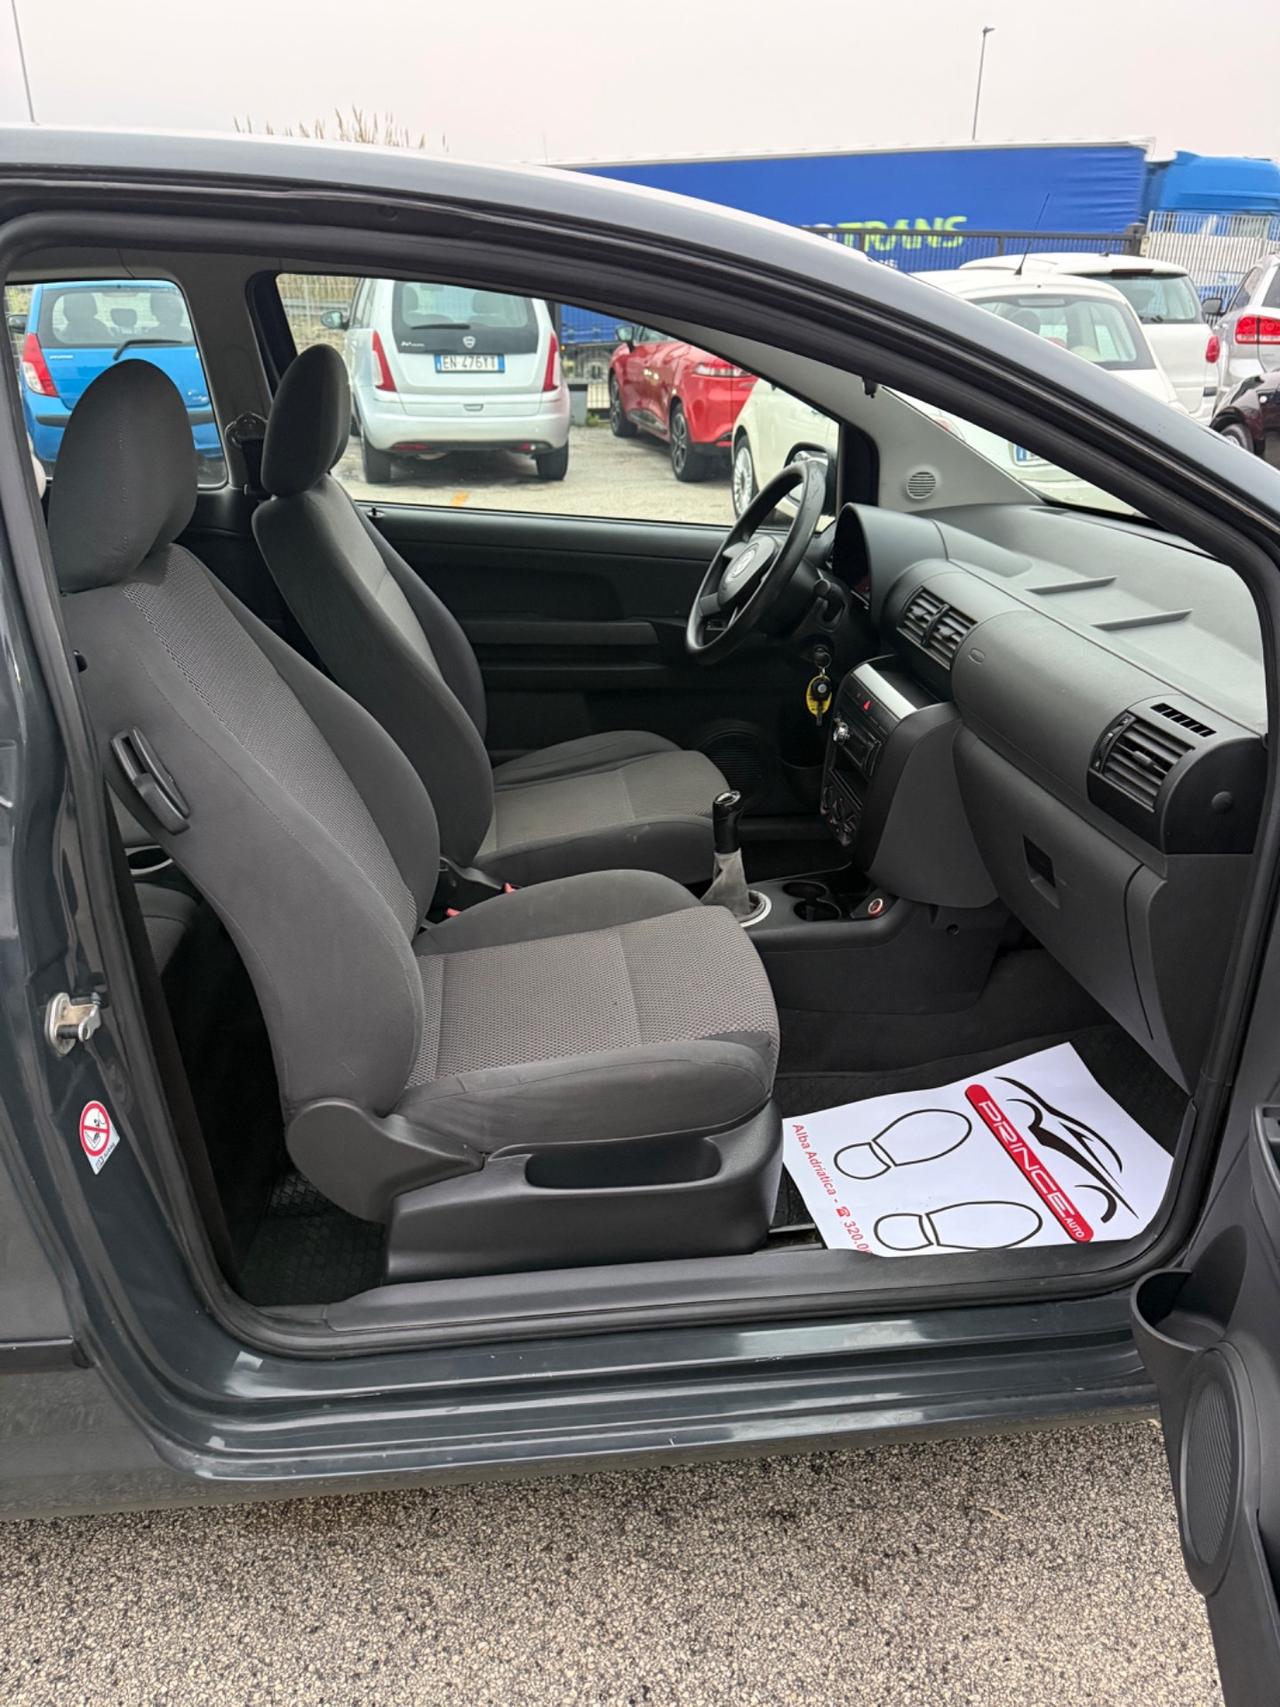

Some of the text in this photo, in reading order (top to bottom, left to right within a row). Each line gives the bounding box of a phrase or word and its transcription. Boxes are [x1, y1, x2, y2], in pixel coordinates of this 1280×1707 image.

[792, 1123, 811, 1150] Alba
[805, 1151, 837, 1196] Adriatica
[979, 1101, 1085, 1239] PRINCE AUTO
